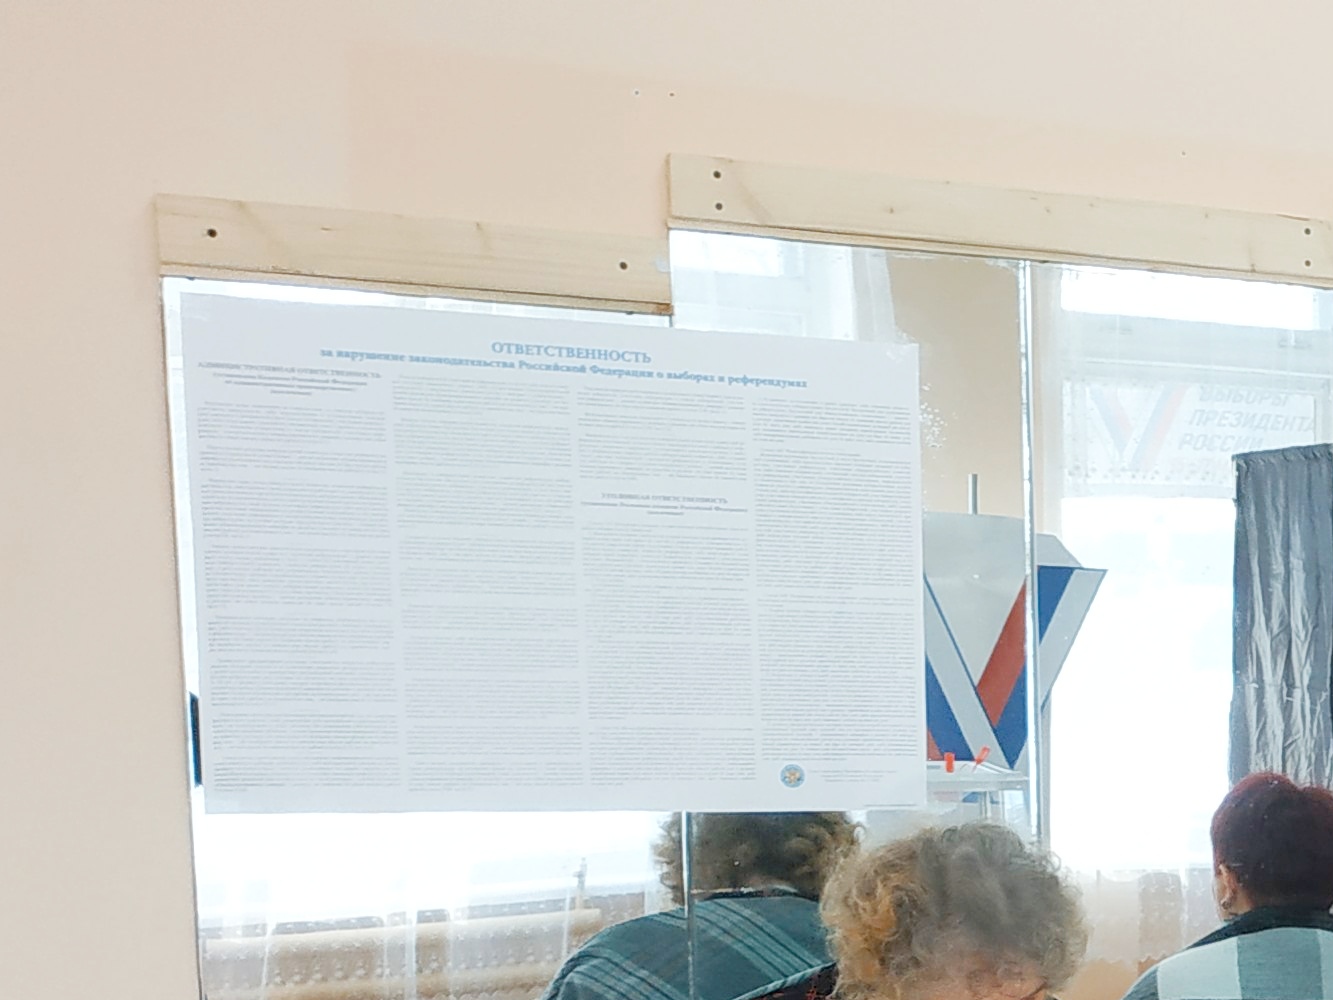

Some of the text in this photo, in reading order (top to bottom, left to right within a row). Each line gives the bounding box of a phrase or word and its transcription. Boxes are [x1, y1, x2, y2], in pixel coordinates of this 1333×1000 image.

[491, 341, 651, 364] ОТВЕТСТВЕННОСТЬ
[320, 349, 334, 358] за
[336, 350, 406, 362] нарушение
[408, 355, 515, 369] законодательства
[518, 360, 587, 373] Российской
[589, 364, 654, 378] Федерации
[666, 371, 715, 383] выборах
[728, 374, 808, 388] референдумах
[1188, 408, 1315, 432] ПРЕЗИДЕНТА
